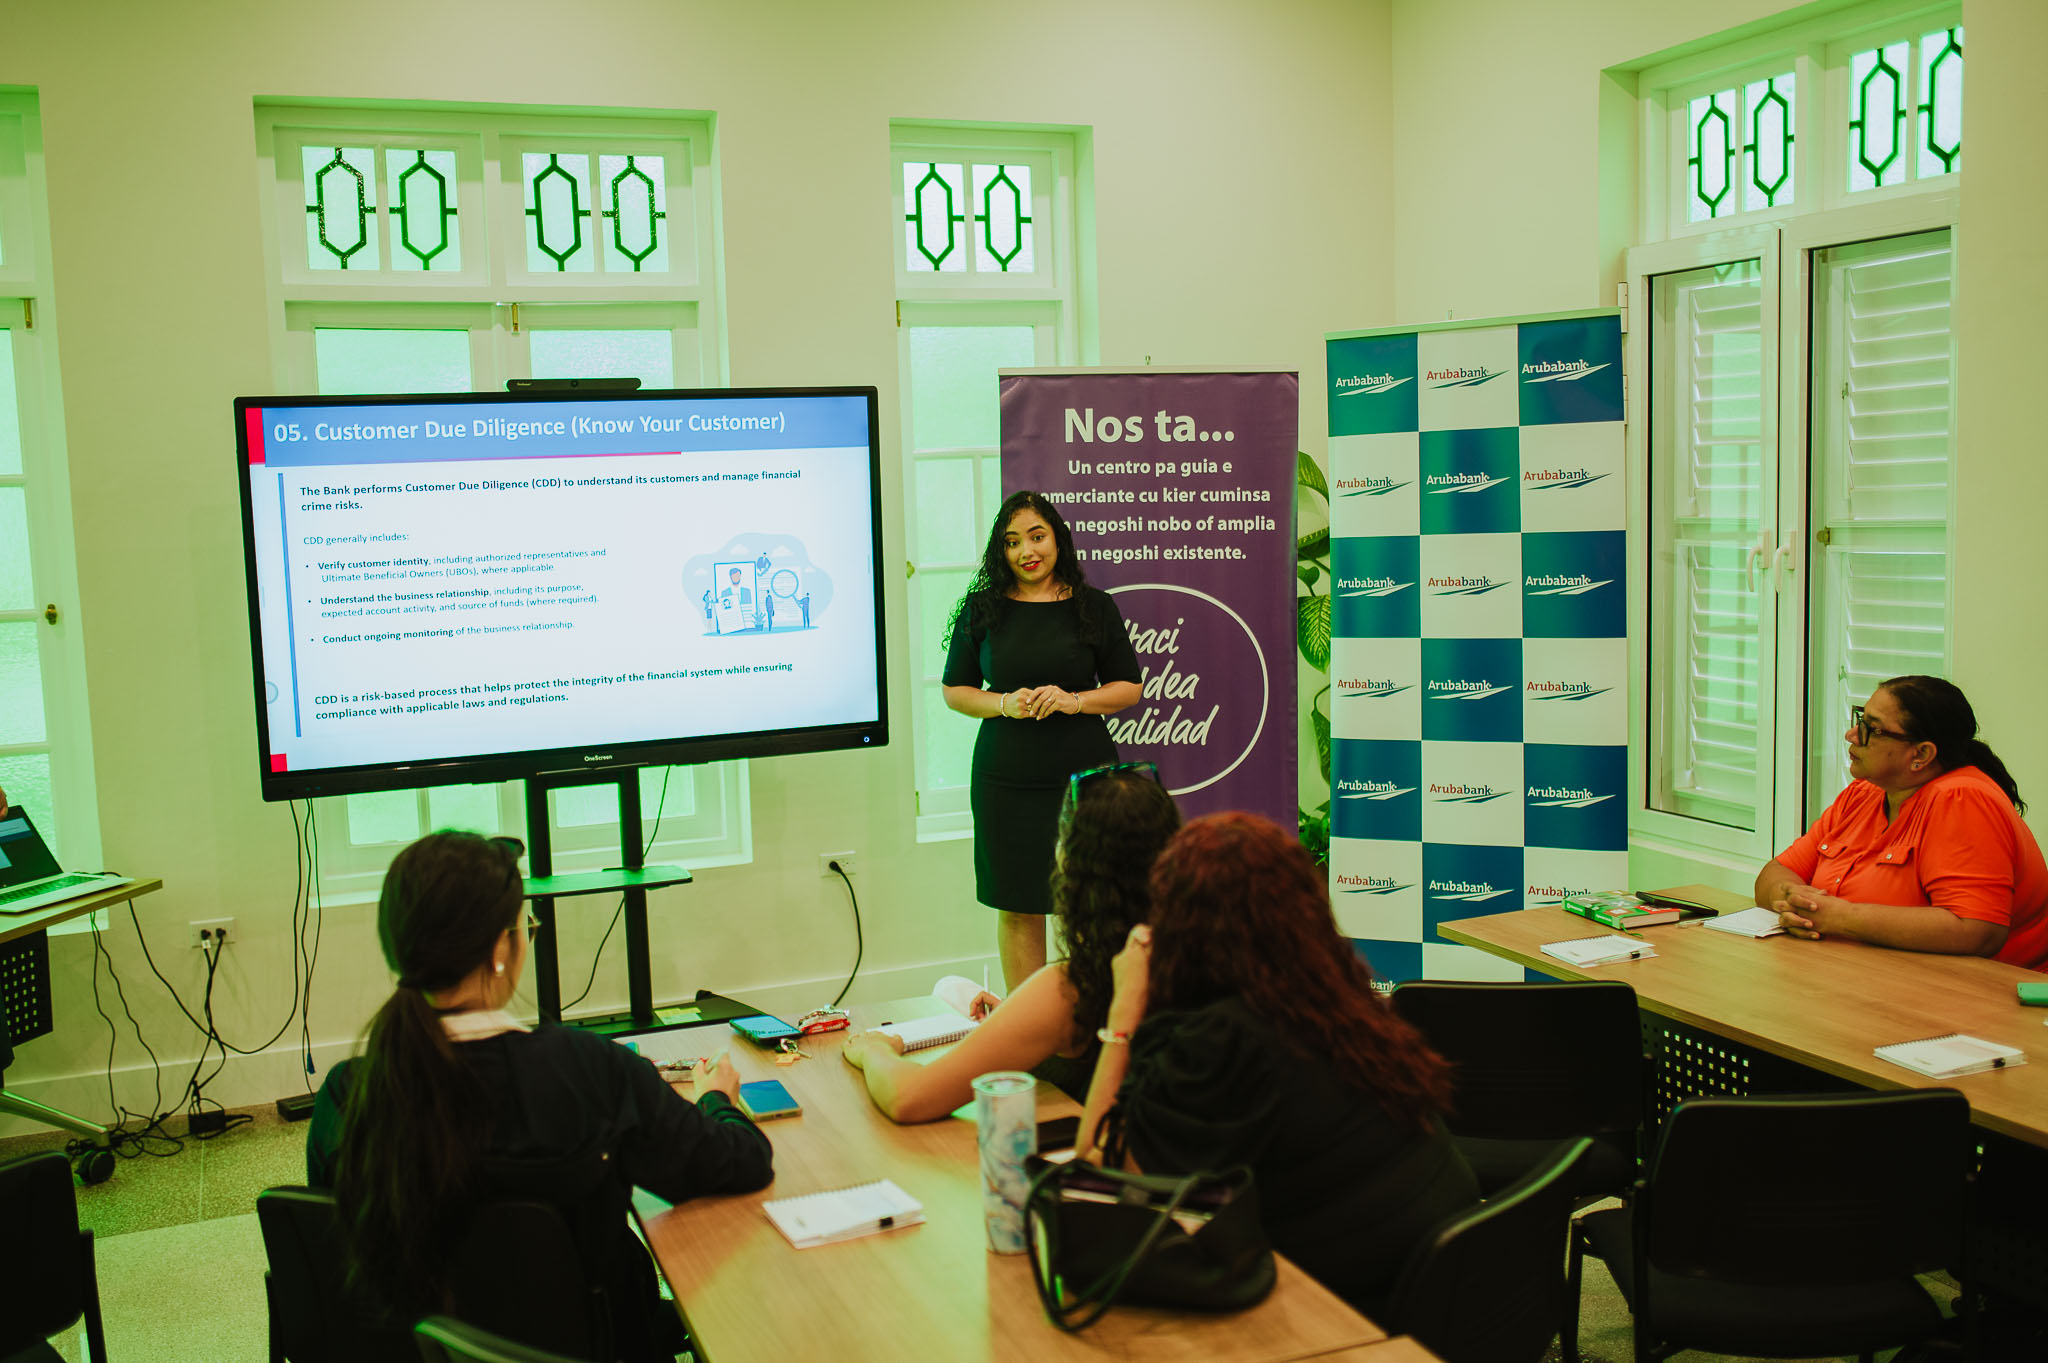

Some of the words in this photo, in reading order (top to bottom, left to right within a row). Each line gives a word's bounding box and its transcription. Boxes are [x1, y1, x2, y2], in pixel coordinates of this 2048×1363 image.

[1426, 366, 1487, 381] Arubabank
[1521, 359, 1588, 374] Arubabank
[1335, 373, 1392, 387] Arubabank
[274, 424, 308, 442] 05.
[315, 422, 419, 441] Customer
[425, 421, 466, 438] Due
[473, 418, 565, 440] Diligence
[571, 415, 634, 438] (Know
[639, 416, 682, 433] Your
[688, 411, 785, 433] Customer)
[1064, 408, 1144, 443] Nos
[1154, 410, 1235, 442] ta...
[1068, 460, 1092, 475] Un
[1096, 460, 1151, 475] centro
[1155, 462, 1176, 477] pa
[1180, 459, 1218, 477] guia
[1222, 462, 1233, 473] e
[1524, 468, 1588, 481] Arubabank
[300, 486, 320, 496] The
[323, 485, 350, 496] Bank
[354, 483, 403, 497] performs
[405, 482, 455, 492] Customer
[459, 481, 479, 491] Due
[482, 479, 529, 491] Diligence
[531, 478, 561, 489] (CDD)
[564, 478, 574, 487] to
[577, 475, 633, 486] understand
[635, 475, 648, 484] its
[650, 474, 699, 484] customers
[702, 472, 720, 482] and
[722, 472, 759, 483] manage
[761, 469, 801, 480] financial
[1336, 476, 1392, 489] Arubabank
[1426, 472, 1490, 485] Arubabank
[1040, 488, 1134, 504] omerciante
[1138, 491, 1158, 502] cu
[1162, 487, 1196, 503] kier
[1200, 487, 1271, 502] cuminsa
[301, 502, 332, 511] crime
[335, 500, 363, 511] risks.
[1075, 516, 1143, 535] negoshi
[1147, 516, 1192, 531] nobo
[1195, 515, 1214, 531] of
[1217, 515, 1276, 534] amplia
[303, 536, 323, 545] CDD
[326, 534, 367, 546] generally
[370, 532, 409, 543] includes:
[318, 560, 346, 571] Verify
[348, 559, 391, 569] customer
[393, 557, 431, 567] identity,
[433, 555, 473, 564] including
[475, 552, 521, 562] authorized
[523, 549, 589, 561] representatives
[590, 548, 606, 557] and
[1091, 545, 1159, 564] negoshi
[1163, 545, 1247, 560] existente.
[321, 573, 361, 583] Ultimate
[363, 570, 407, 581] Beneficial
[409, 569, 443, 578] Owners
[446, 567, 479, 578] (UBOs),
[481, 565, 509, 574] where
[1525, 574, 1590, 587] Arubabank
[1337, 576, 1394, 589] Arubabank
[1428, 575, 1490, 588] Arubabank
[320, 594, 374, 605] Understand
[377, 594, 393, 602] the
[394, 591, 434, 601] business
[494, 586, 533, 595] including
[534, 585, 545, 593] its
[547, 584, 584, 594] purpose,
[321, 608, 363, 619] expected
[365, 606, 401, 616] account
[403, 604, 437, 613] activity,
[439, 602, 456, 611] and
[458, 602, 487, 610] source
[489, 599, 498, 608] of
[500, 598, 524, 608] funds
[526, 597, 556, 608] (where
[558, 594, 599, 605] required).
[323, 634, 361, 644] Conduct
[364, 631, 401, 642] ongoing
[403, 628, 454, 639] monitoring
[455, 626, 465, 635] of
[467, 625, 482, 635] the
[483, 623, 521, 634] business
[315, 695, 338, 705] CDD
[341, 694, 350, 704] is
[361, 689, 415, 701] risk-based
[418, 688, 458, 699] process
[460, 685, 481, 695] that
[484, 682, 511, 694] helps
[514, 680, 550, 692] protect
[552, 679, 570, 688] the
[572, 675, 614, 687] integrity
[616, 673, 627, 683] of
[628, 672, 645, 682] the
[647, 669, 688, 681] financial
[690, 667, 723, 678] system
[725, 665, 751, 674] while
[753, 662, 793, 673] ensuring
[1337, 679, 1394, 691] Arubabank
[1428, 679, 1491, 691] Arubabank
[1526, 680, 1590, 693] Arubabank
[315, 708, 377, 720] compliance
[379, 705, 404, 715] with
[406, 701, 460, 714] applicable
[462, 698, 485, 709] laws
[487, 696, 507, 707] and
[509, 693, 569, 705] regulations.
[1101, 704, 1220, 746] ealidad
[584, 754, 613, 762] OneScreen
[1337, 779, 1396, 792] Arubabank
[1430, 783, 1492, 796] Arubabank
[1527, 786, 1592, 800] Arubabank
[1337, 874, 1396, 888] Arubabank
[1429, 880, 1492, 893] Arubabank
